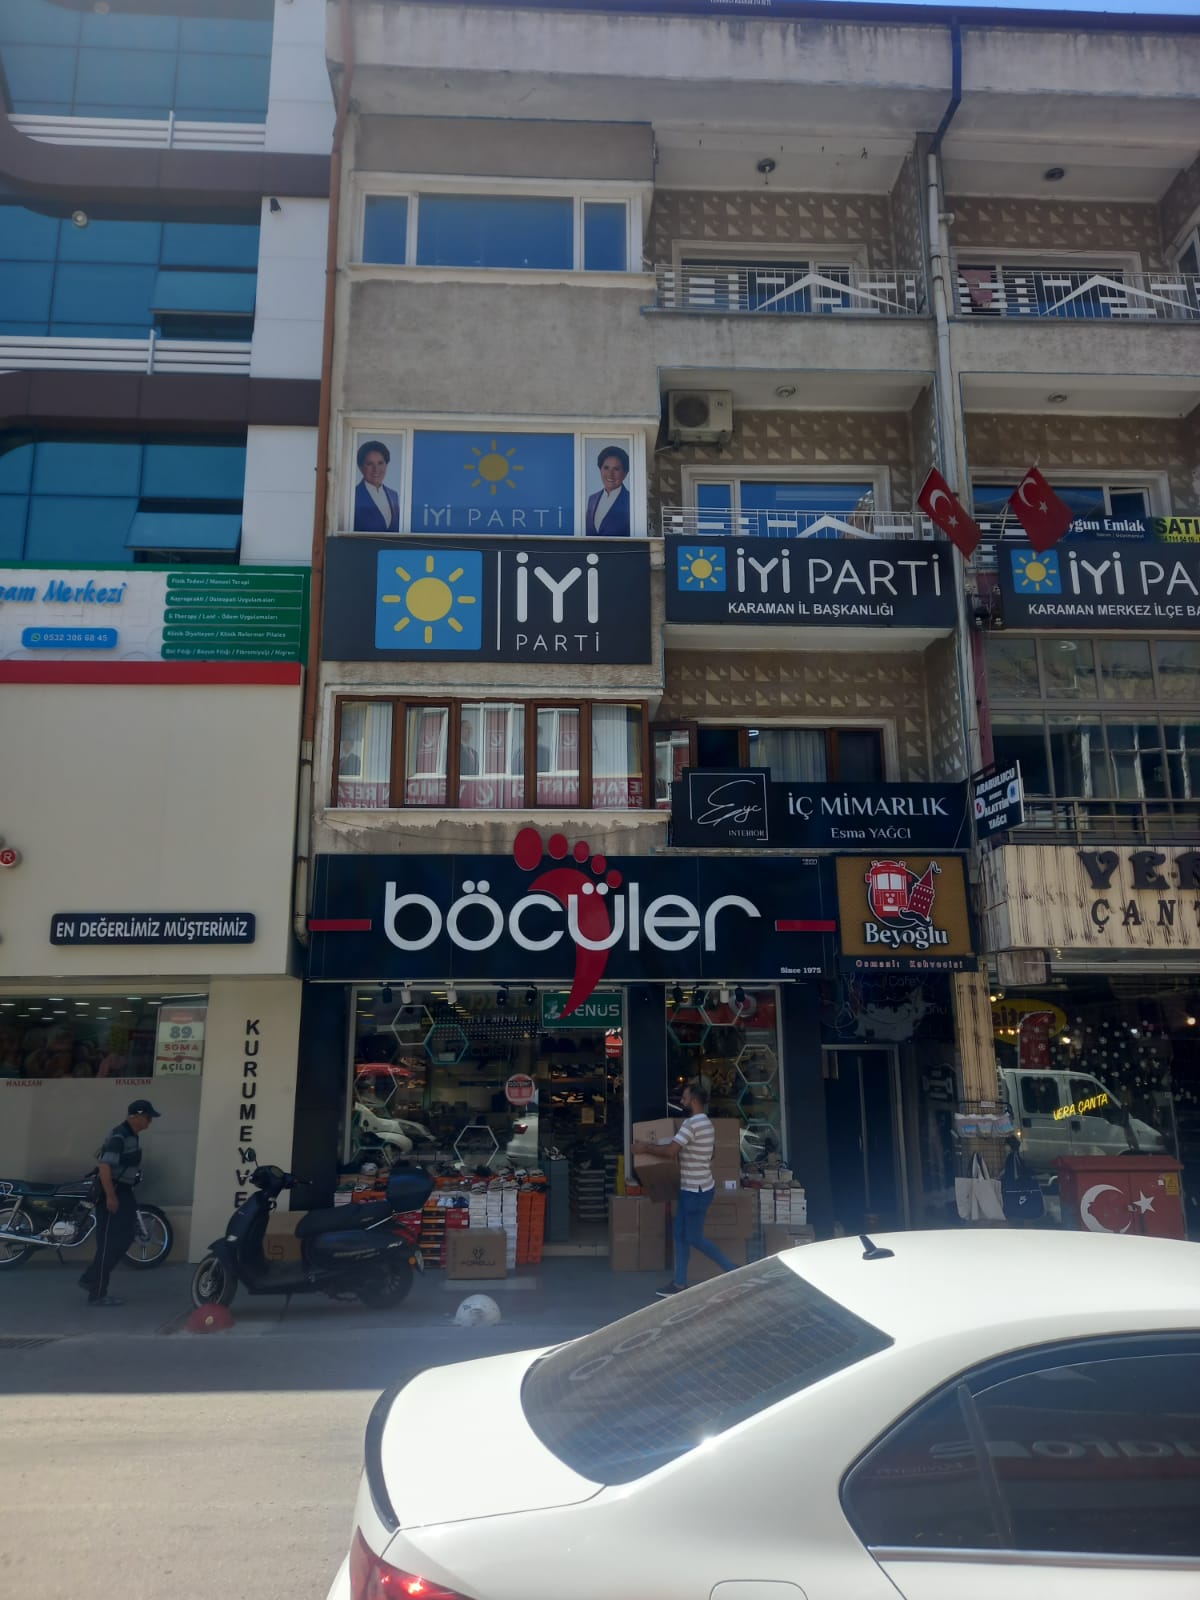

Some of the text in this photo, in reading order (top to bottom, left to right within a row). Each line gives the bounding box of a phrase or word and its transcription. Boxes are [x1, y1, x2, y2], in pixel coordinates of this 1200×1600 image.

[423, 504, 562, 528] İYİ PARTİ
[1104, 518, 1145, 532] Emlak
[736, 548, 941, 596] İYİ PARTİ
[1068, 551, 1124, 594] İYİ
[42, 580, 128, 603] Merkezi
[516, 552, 599, 624] İYİ
[728, 600, 894, 618] KARAMAN İL BAŞKANLIĞI
[1029, 604, 1094, 615] KARAMAN
[1098, 604, 1152, 616] MERKEZ
[1154, 602, 1184, 618] İLÇE
[516, 632, 600, 652] PARTİ
[788, 792, 949, 820] İÇ MİMARLIK
[831, 826, 912, 840] Esma YAĞCI
[384, 880, 762, 952] böcüler
[56, 917, 247, 940] EN DEĞERLİMİZ MÜŞTERİMİZ
[864, 922, 949, 949] Beyoğlu
[856, 960, 900, 969] Osmanlı
[161, 1064, 196, 1073] AÇILDI
[1078, 1094, 1108, 1116] ÇANTA
